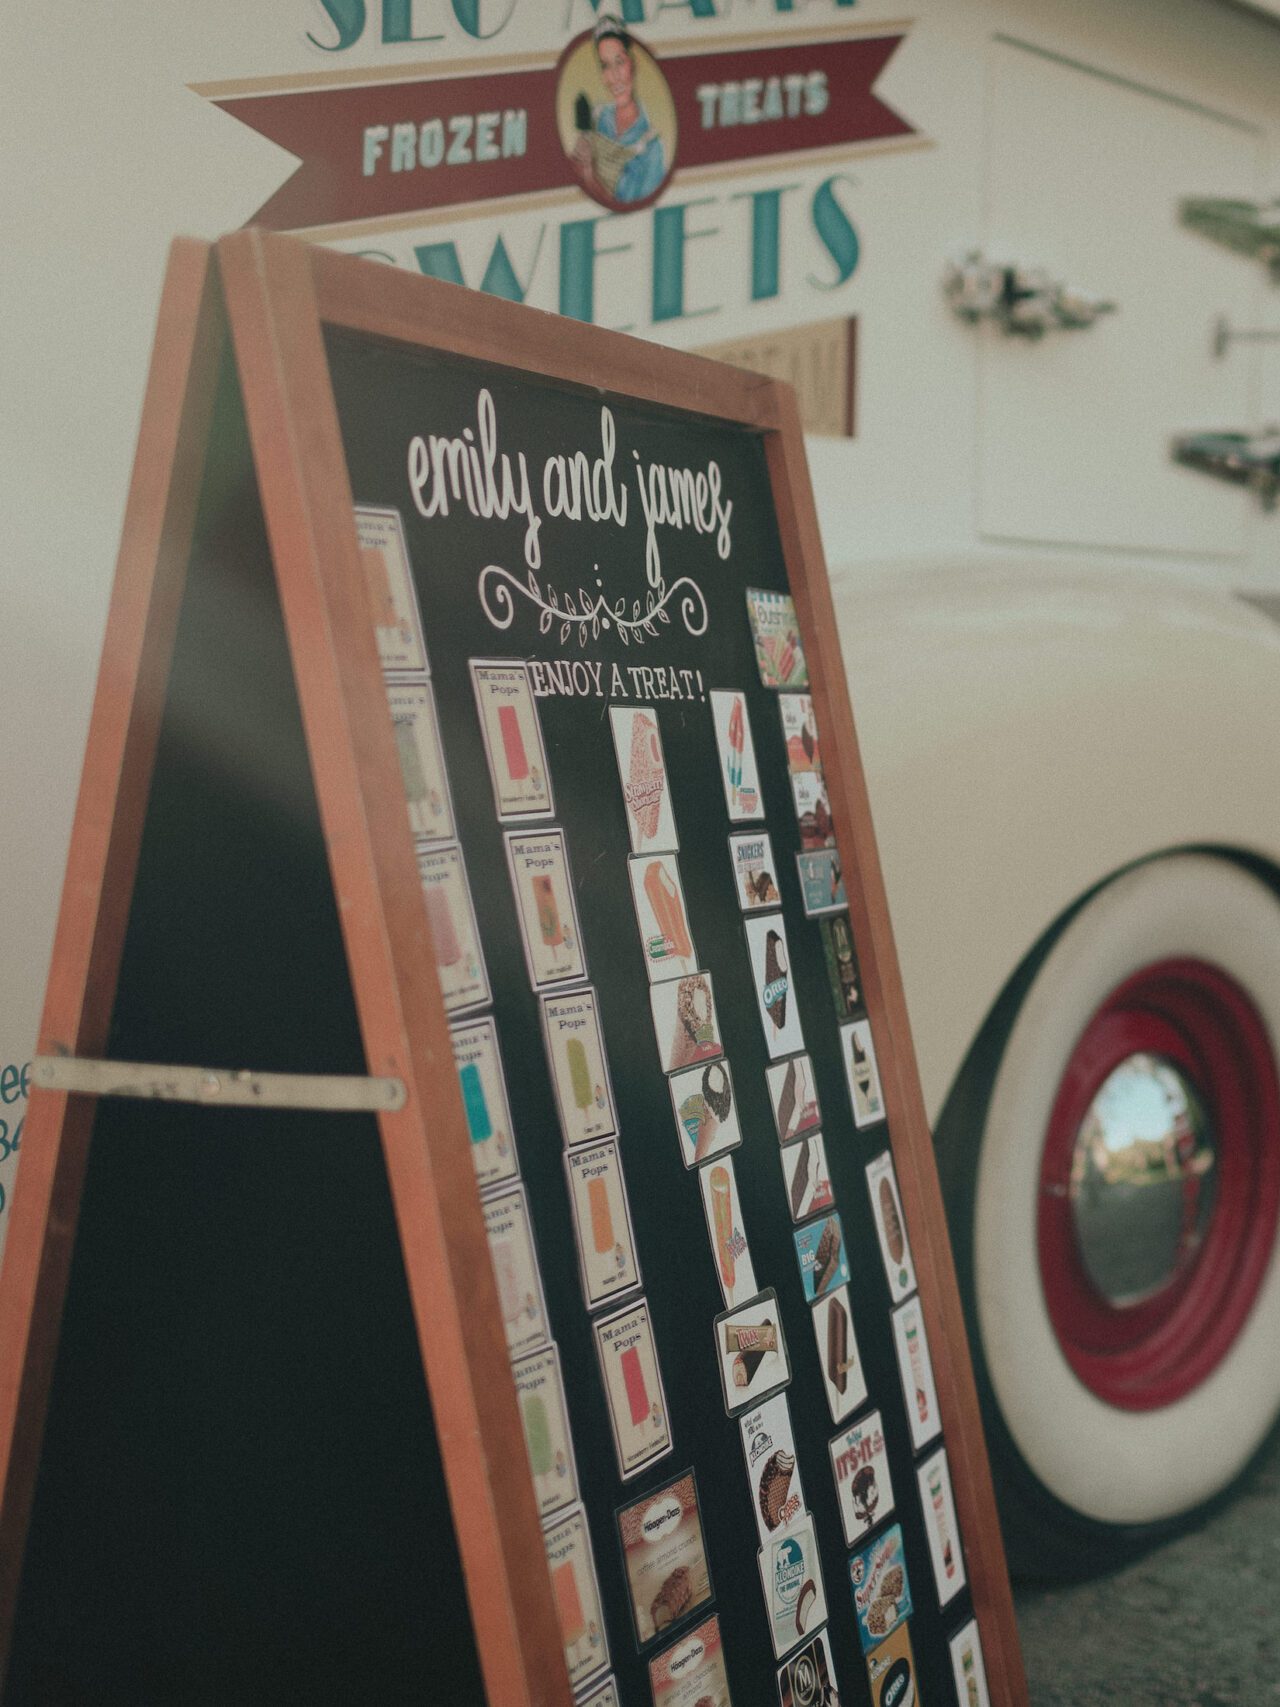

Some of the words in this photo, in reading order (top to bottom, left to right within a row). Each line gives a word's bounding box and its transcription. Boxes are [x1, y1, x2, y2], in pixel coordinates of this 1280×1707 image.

[362, 109, 529, 177] FROZEN
[697, 71, 830, 130] TREATS
[346, 174, 862, 332] WEETS
[408, 388, 542, 569] emily
[543, 405, 628, 527] and
[632, 450, 733, 588] james
[479, 670, 525, 681] Mama's
[527, 660, 603, 698] ENJOY
[611, 662, 625, 698] A
[628, 666, 705, 703] TREAT!
[489, 684, 520, 697] Pops
[513, 842, 561, 856] Mama's
[525, 858, 554, 870] Pops
[764, 979, 788, 1006] OREO
[548, 1003, 593, 1018] Mama's
[559, 1019, 587, 1030] Pops
[571, 1147, 615, 1168] Mama's
[581, 1163, 609, 1179] Pops
[602, 1315, 647, 1343] Mama's
[613, 1332, 642, 1352] Pops
[885, 1674, 905, 1706] OREO
